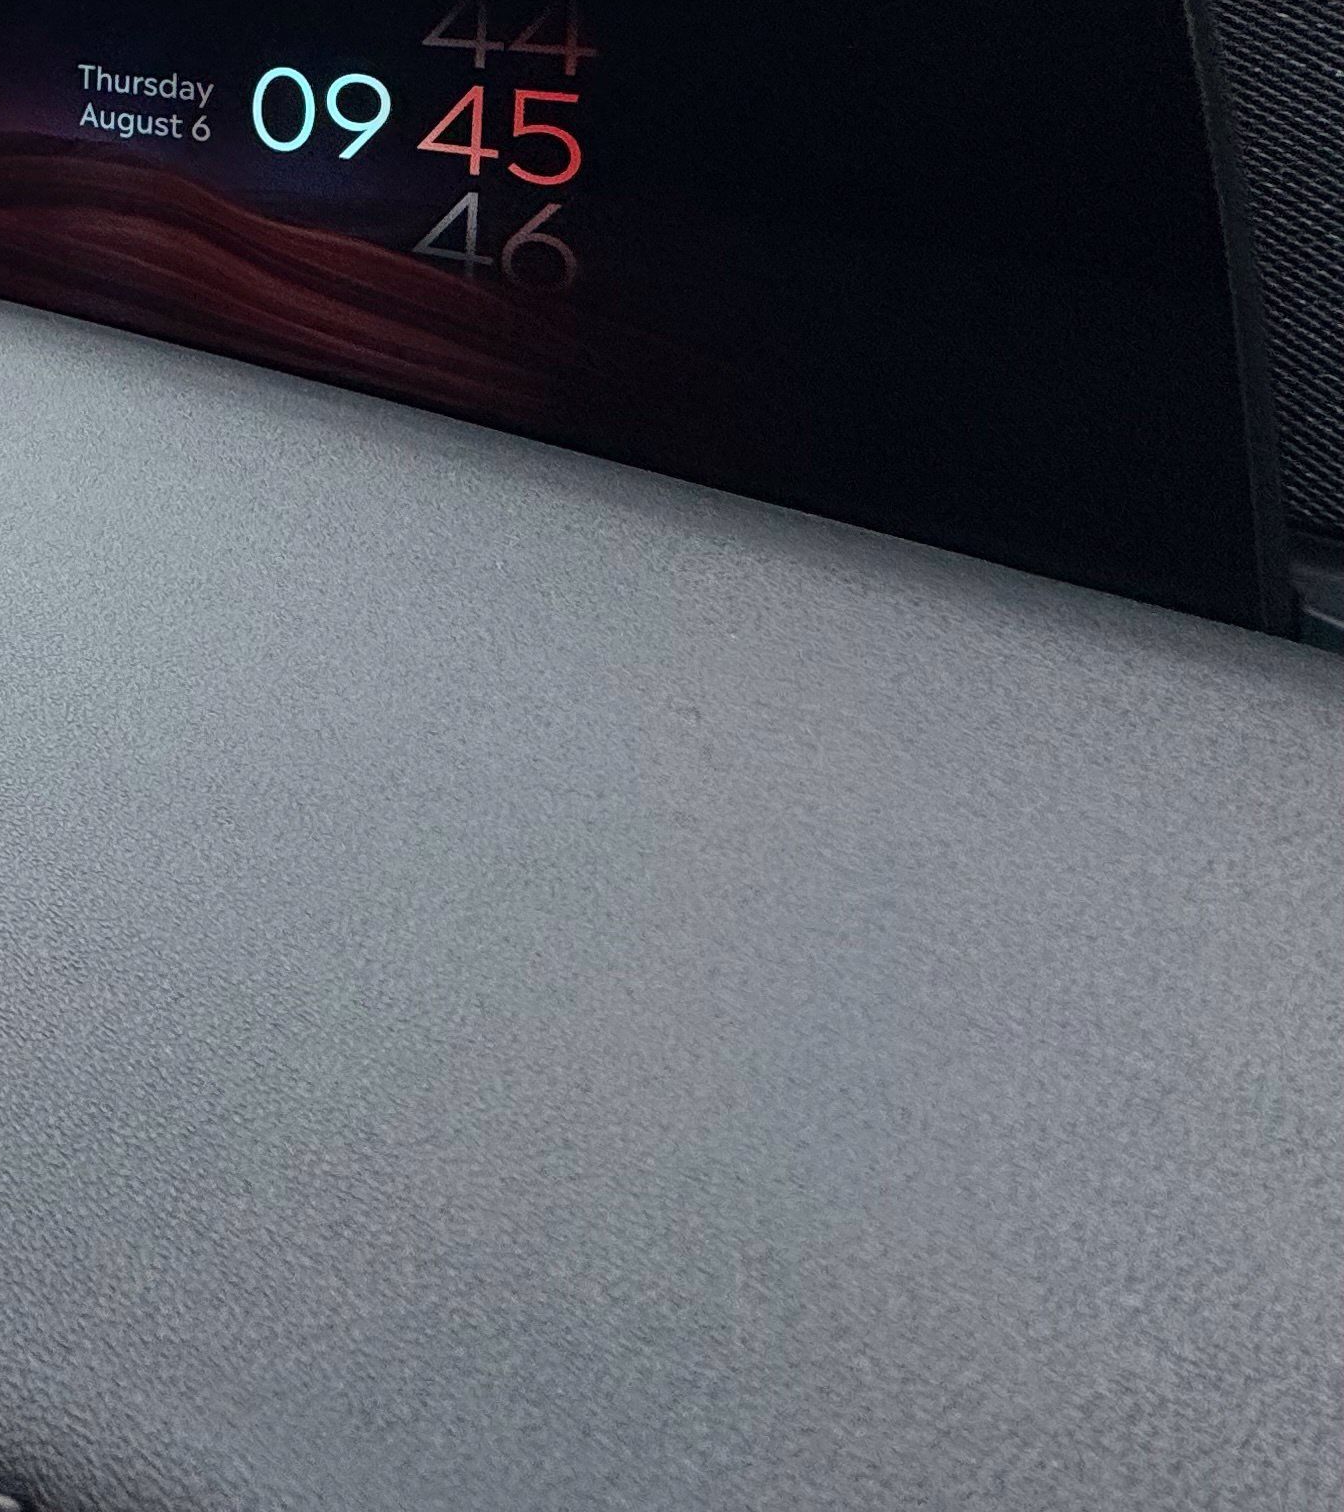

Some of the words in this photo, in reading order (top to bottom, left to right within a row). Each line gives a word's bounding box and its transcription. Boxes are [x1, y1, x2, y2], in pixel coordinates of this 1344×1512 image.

[77, 64, 214, 109] Thursday
[79, 101, 184, 139] August
[191, 115, 211, 142] 6
[252, 66, 392, 160] 09
[416, 84, 583, 186] 45
[412, 191, 577, 289] 46
